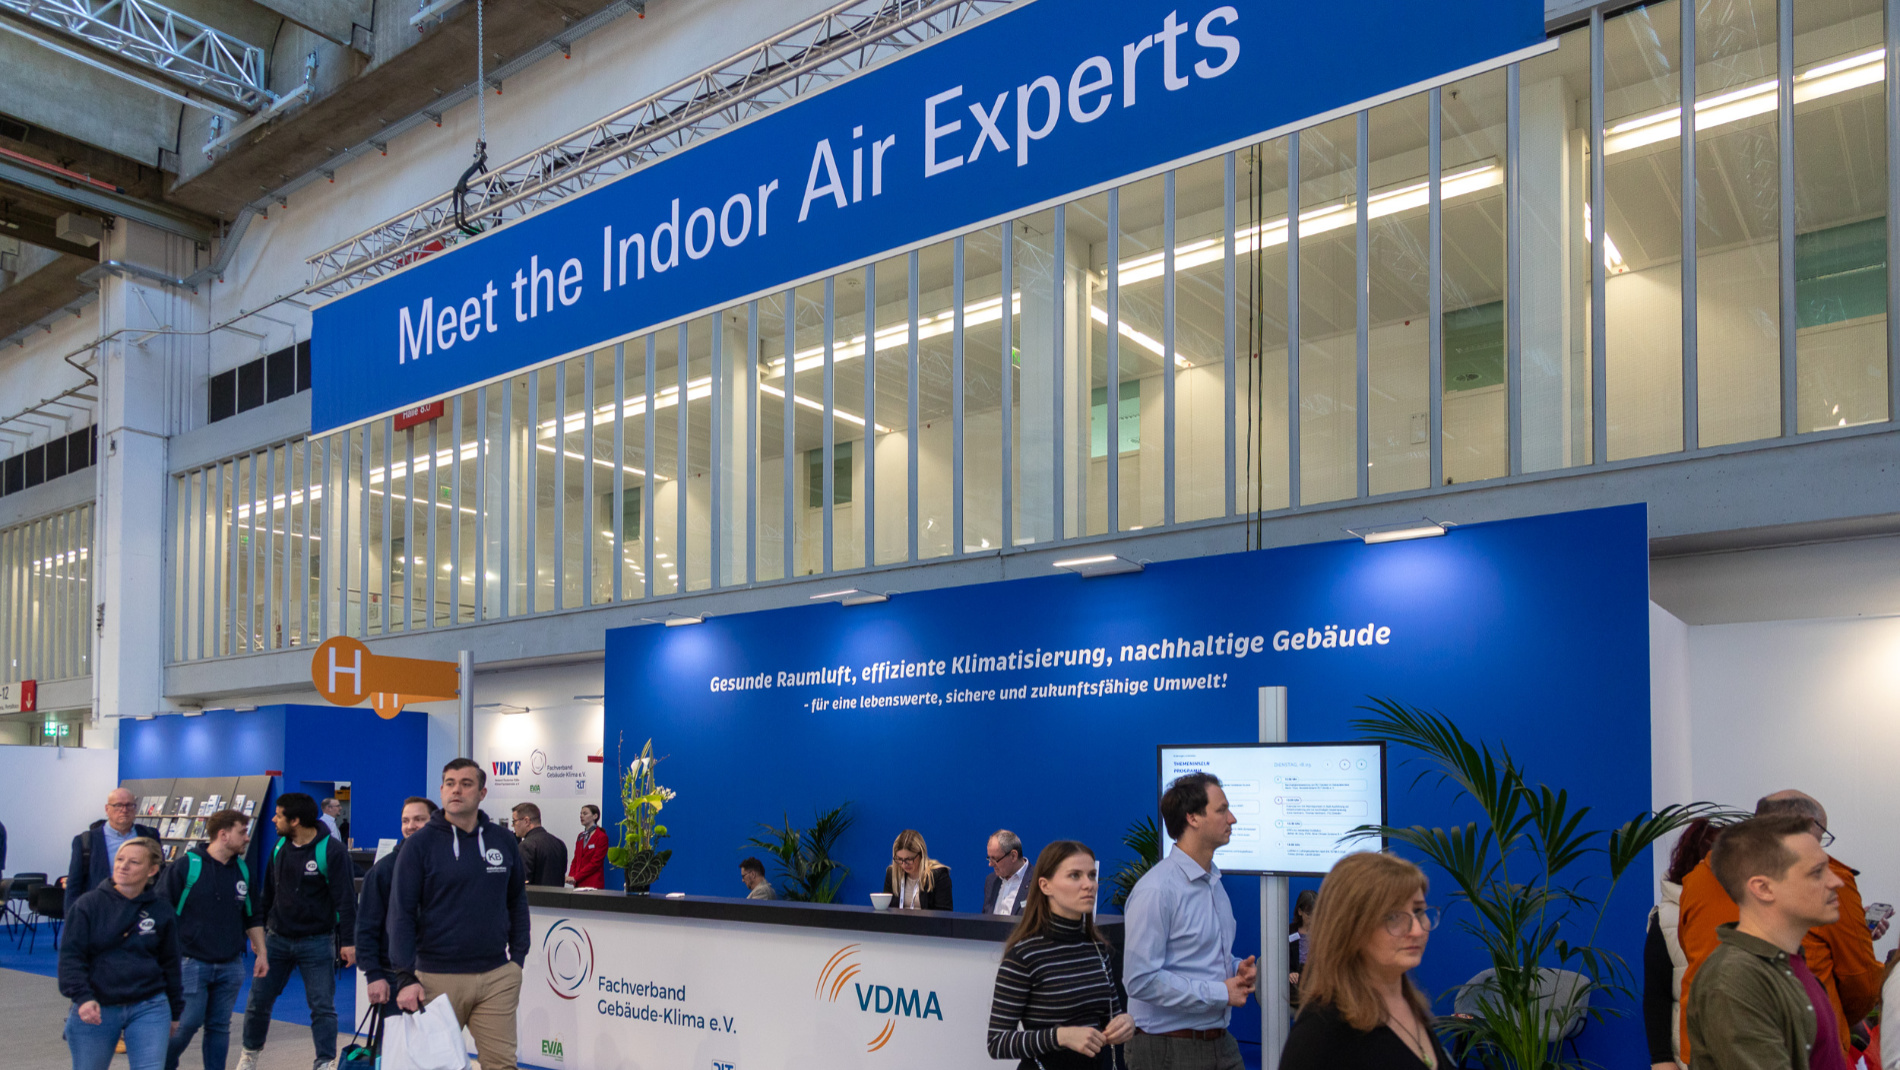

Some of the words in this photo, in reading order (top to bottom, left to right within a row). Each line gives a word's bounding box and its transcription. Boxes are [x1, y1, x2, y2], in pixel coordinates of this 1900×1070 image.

[399, 280, 498, 365] Meet
[511, 254, 583, 323] the
[603, 178, 779, 292] Indoor
[797, 124, 896, 223] Air
[924, 5, 1241, 178] Experts
[328, 646, 361, 695] H
[709, 672, 773, 693] Gesunde
[776, 665, 857, 688] Raumluft,
[861, 660, 946, 684] effiziente
[951, 647, 1113, 675] Klimatisierung,
[1119, 632, 1265, 662] nachhaltige
[1272, 622, 1392, 652] Gebäude
[811, 697, 830, 714] für
[831, 696, 858, 710] eine
[859, 692, 943, 709] lebenswerte,
[945, 688, 996, 704] sichere
[999, 685, 1027, 700] und
[1030, 677, 1149, 699] zukunftsfähige
[1153, 673, 1228, 692] Umwelt!
[492, 761, 521, 776] VDKF
[597, 975, 686, 1002] Fachverband
[854, 982, 944, 1021] VDMA
[597, 999, 705, 1030] Gebäude-Klima
[709, 1016, 738, 1034] e.V.
[541, 1039, 564, 1056] EVIA
